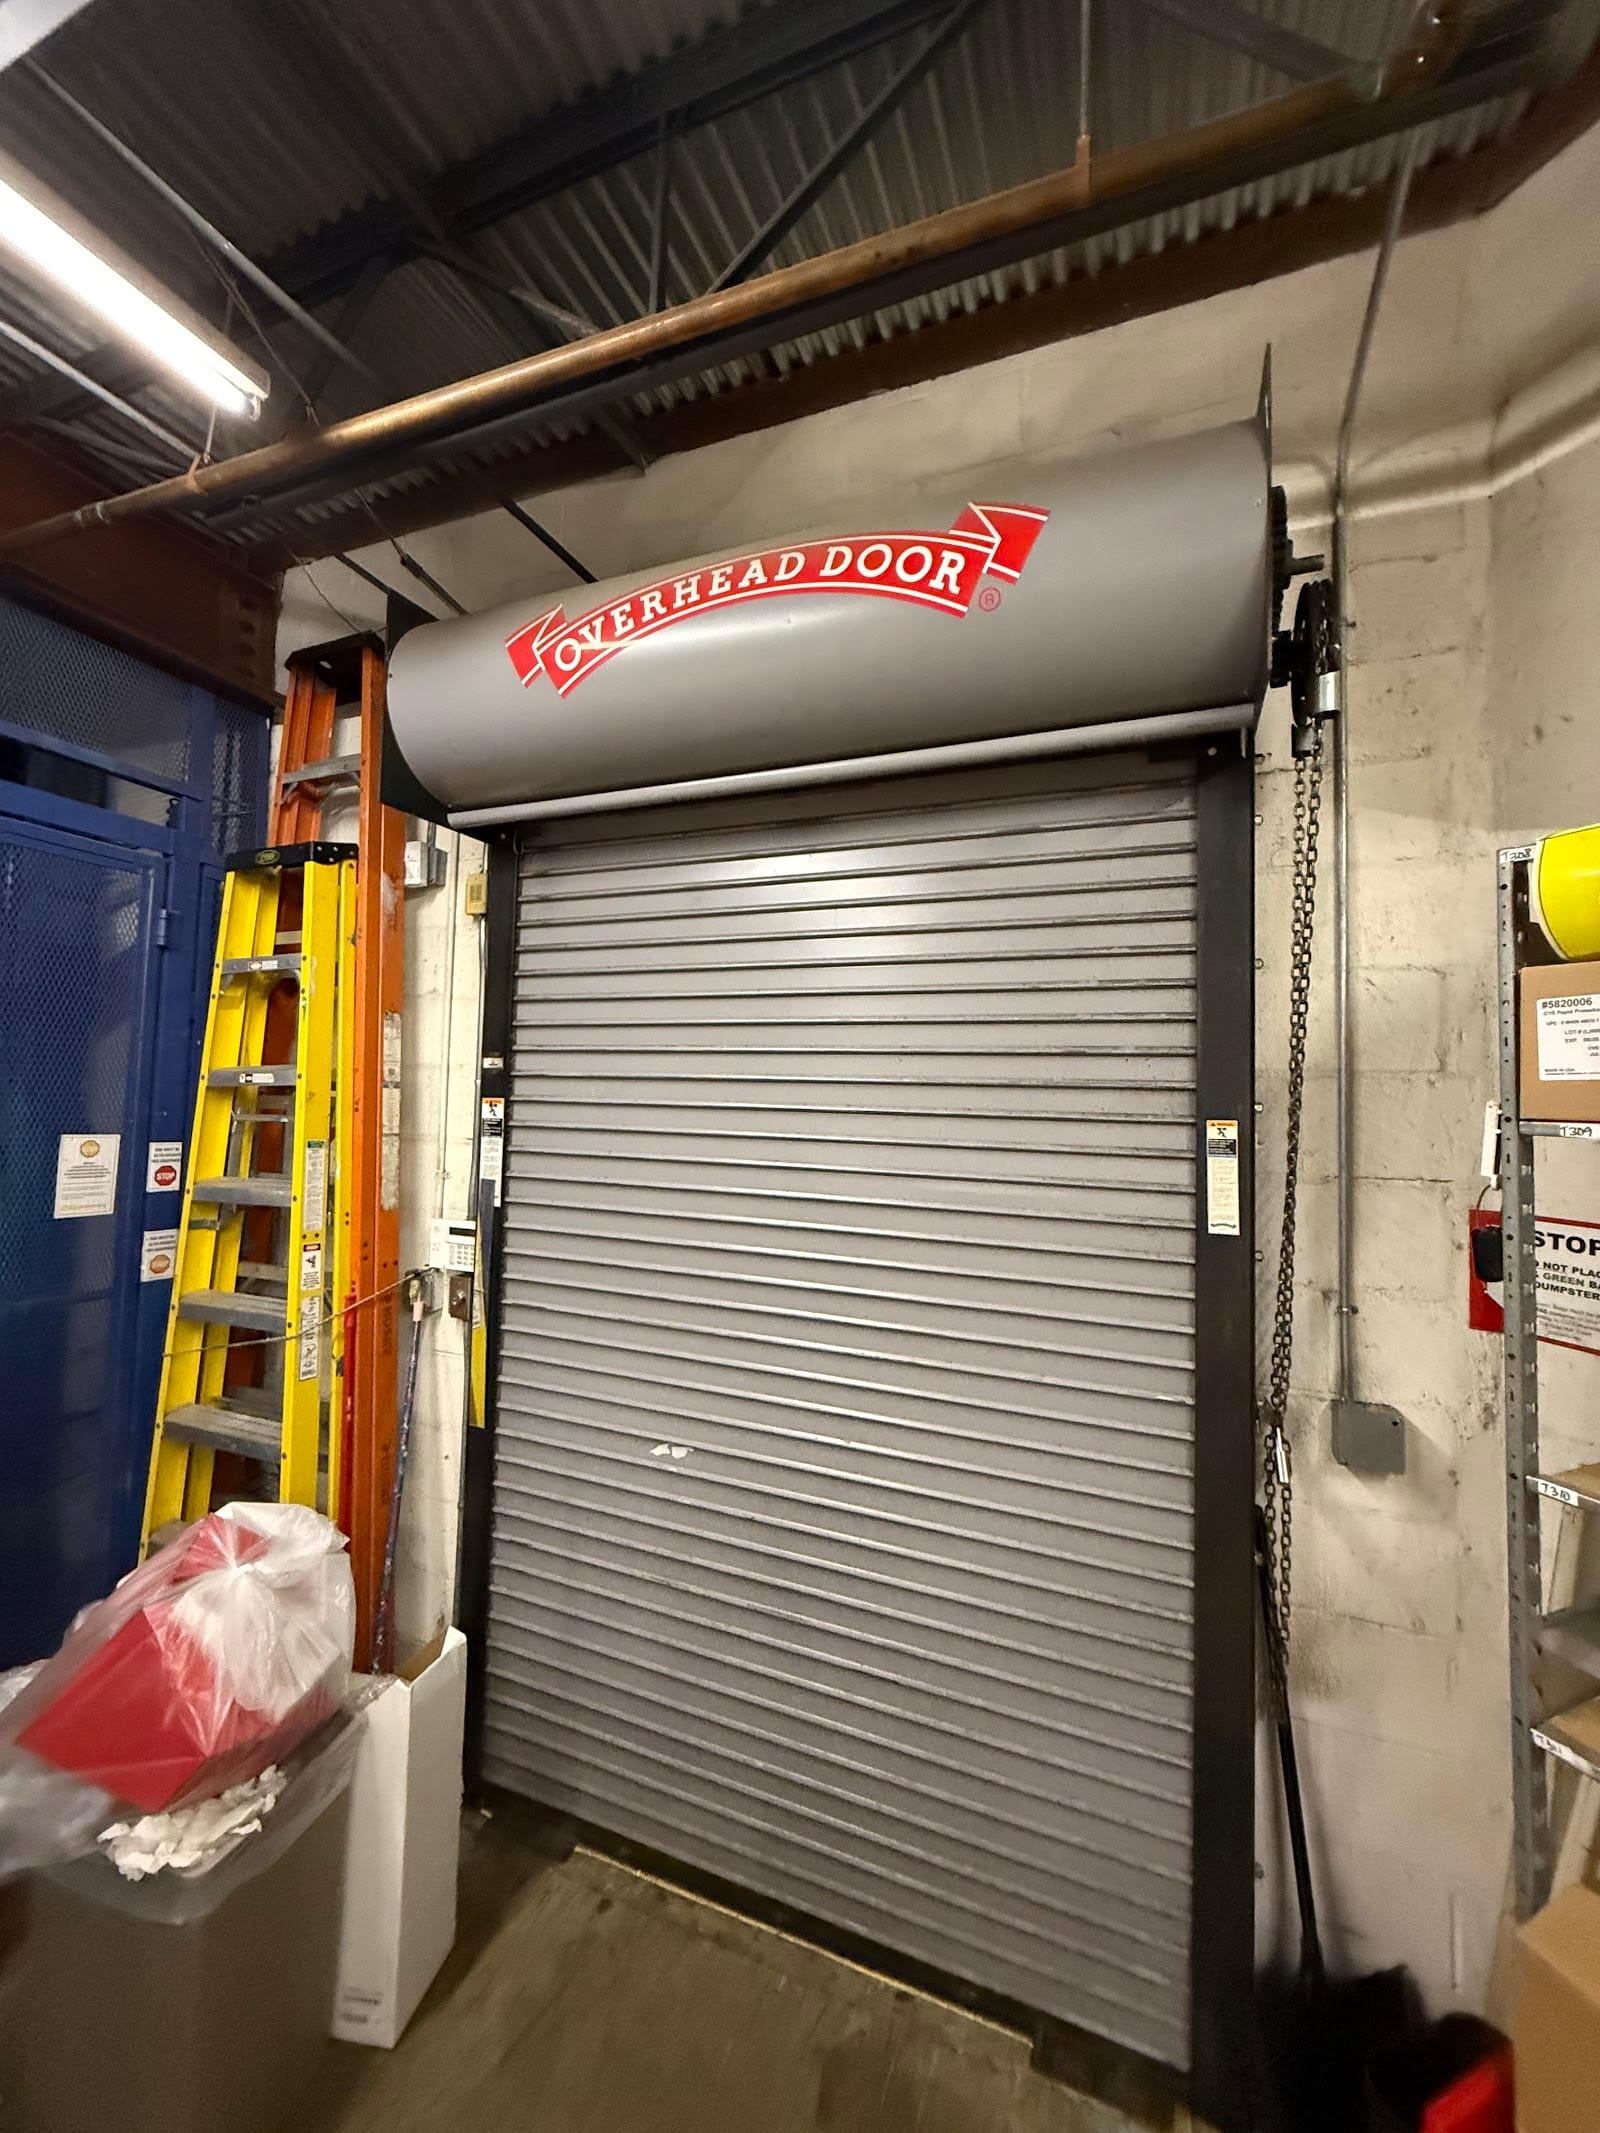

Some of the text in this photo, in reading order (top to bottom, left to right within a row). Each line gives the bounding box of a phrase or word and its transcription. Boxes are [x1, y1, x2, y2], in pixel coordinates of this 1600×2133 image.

[554, 551, 806, 672] OVERHEAD
[819, 543, 966, 595] DOOR
[1542, 997, 1593, 1009] #5820006
[1560, 1126, 1593, 1137] T309
[1543, 1261, 1568, 1273] NOT
[1543, 1272, 1584, 1287] GREEN
